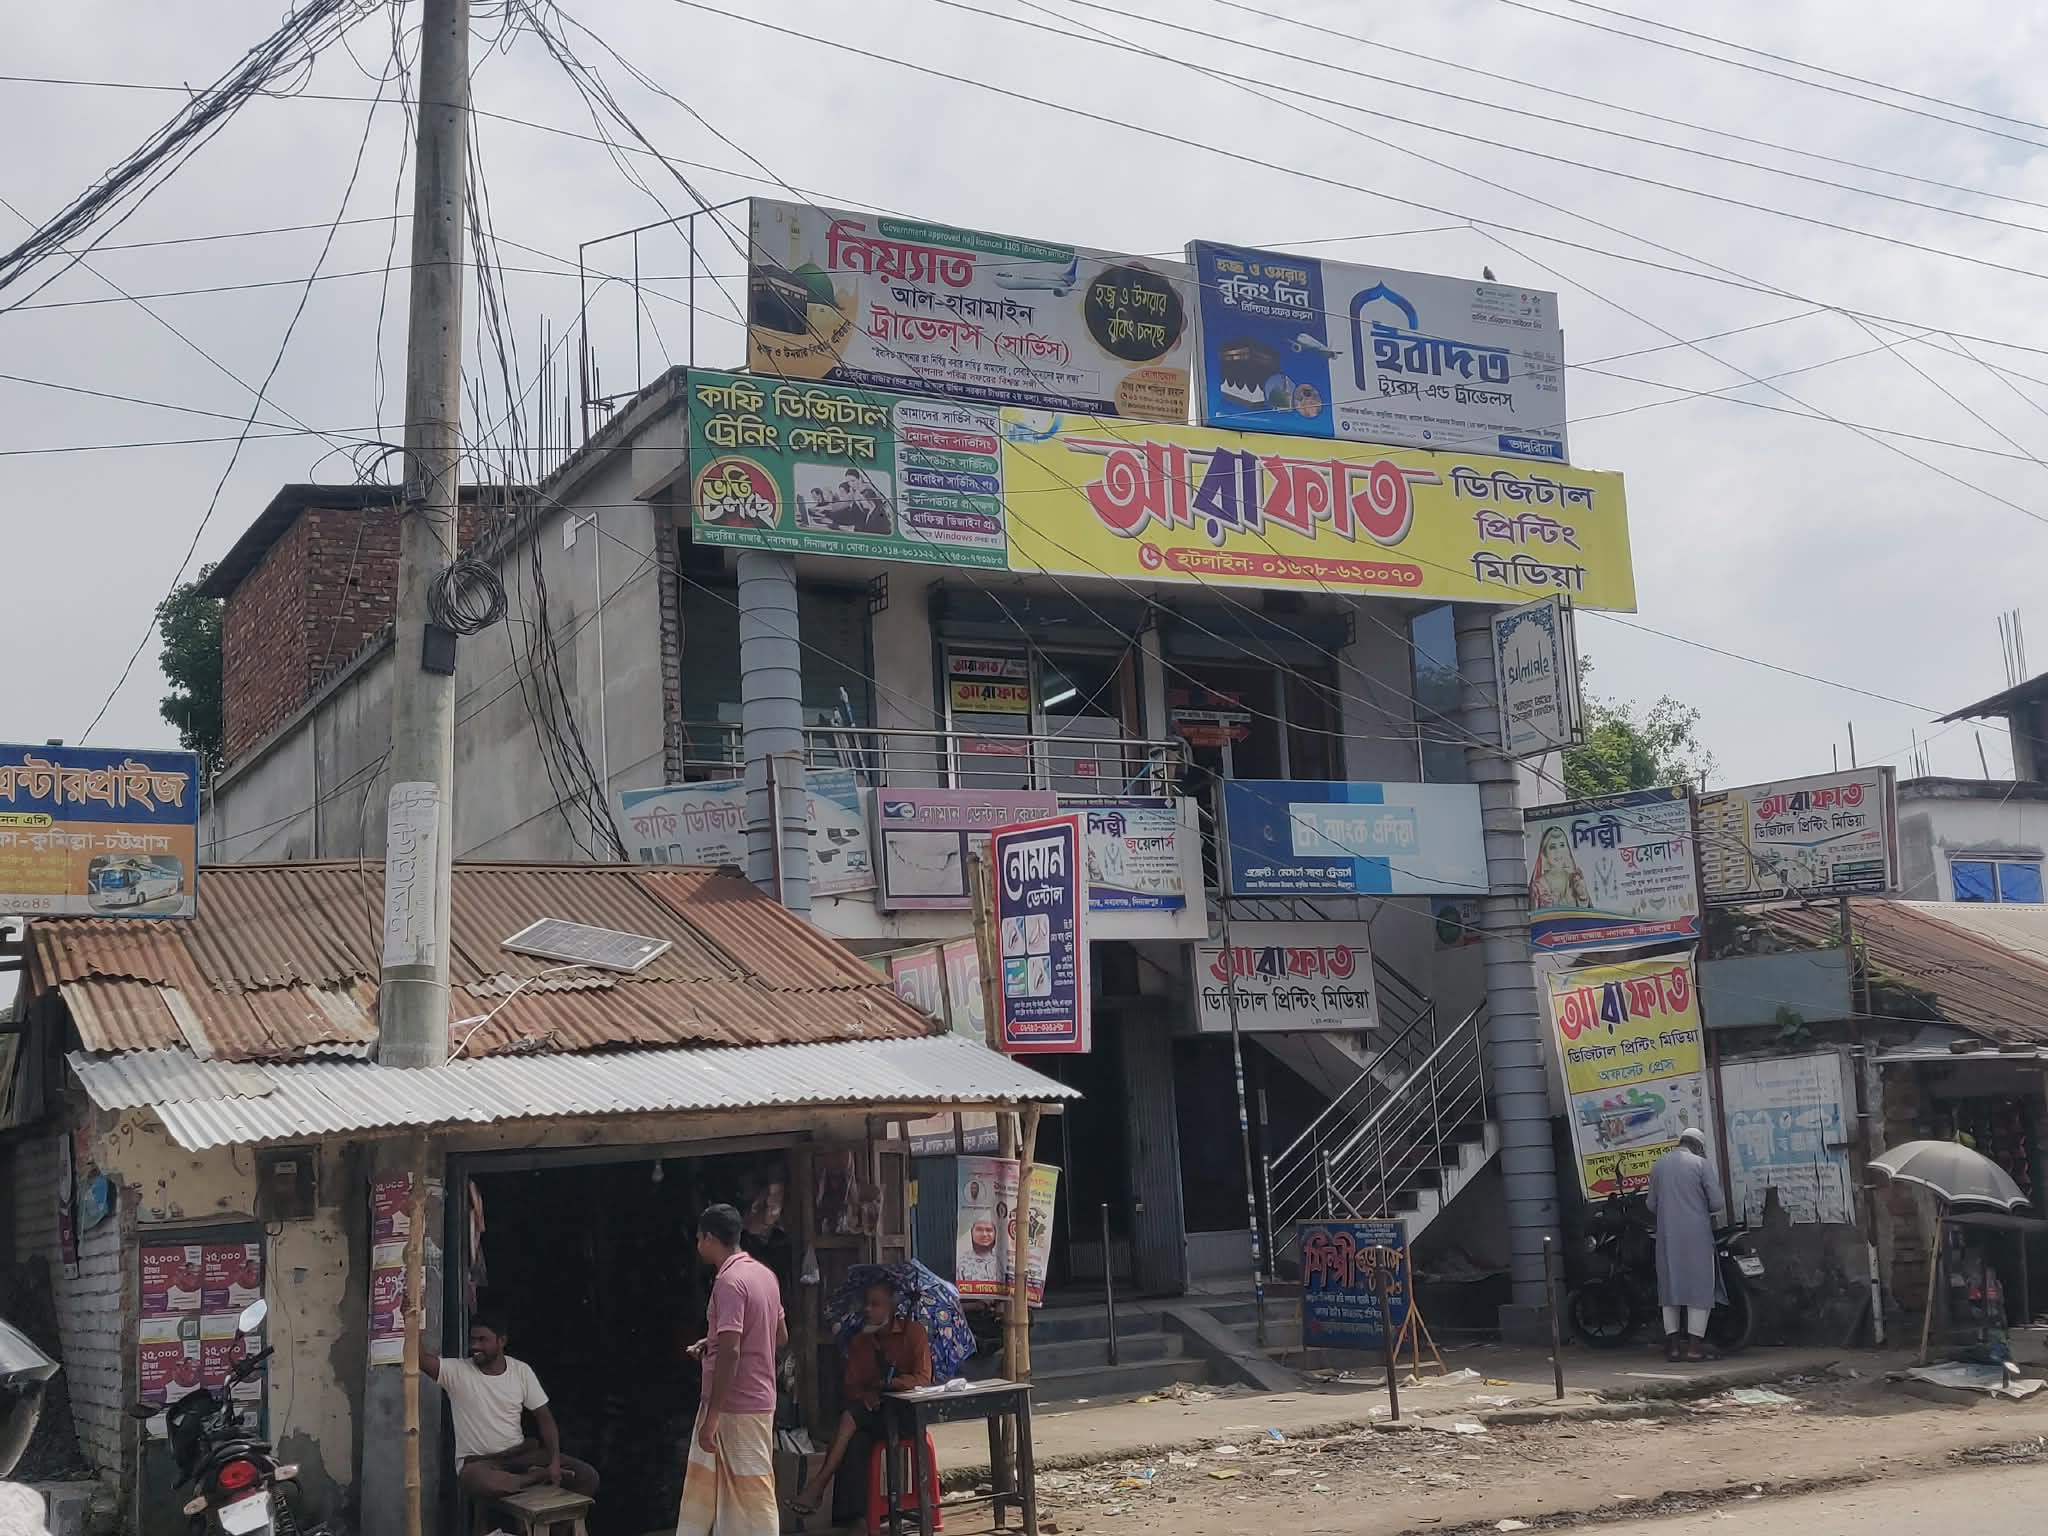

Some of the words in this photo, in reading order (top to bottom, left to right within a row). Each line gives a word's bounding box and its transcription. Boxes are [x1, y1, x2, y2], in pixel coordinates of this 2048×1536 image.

[883, 222, 927, 238] Government
[928, 230, 961, 244] approved
[890, 287, 1036, 325] আল-হারামাইন
[1217, 275, 1271, 305] বুকিং
[1273, 280, 1310, 308] দিন
[993, 331, 1072, 368] (সার্ভিস)
[1370, 319, 1510, 385] ইবাদত
[696, 381, 765, 415] কাফি
[772, 385, 890, 428] ডিজিটাল
[900, 406, 939, 422] আমাদের
[704, 412, 781, 453] ট্রেনিং
[788, 425, 876, 460] সেন্টার
[1064, 438, 1445, 548] আরাফাত
[1448, 466, 1596, 511] ডিজিটাল
[934, 530, 974, 543] Windows
[1473, 509, 1583, 551] প্রিন্টিং
[1470, 551, 1589, 592] মিডিয়া
[630, 806, 679, 840] কাফি
[681, 800, 750, 835] ডিজিটা
[1754, 782, 1871, 821] আরাফাত
[1003, 836, 1065, 901] নোমান
[1026, 883, 1065, 909] ডেন্টাল
[1205, 944, 1362, 986] আরাফাত
[1272, 986, 1320, 1013] প্রিন্টিং
[1321, 985, 1370, 1011] মিডিয়া
[1552, 966, 1691, 1041] আরাফাত
[1567, 1043, 1618, 1066] ডিজিটাল
[1620, 1037, 1657, 1057] প্রিন্টিং
[1658, 1028, 1700, 1050] মিডিয়া
